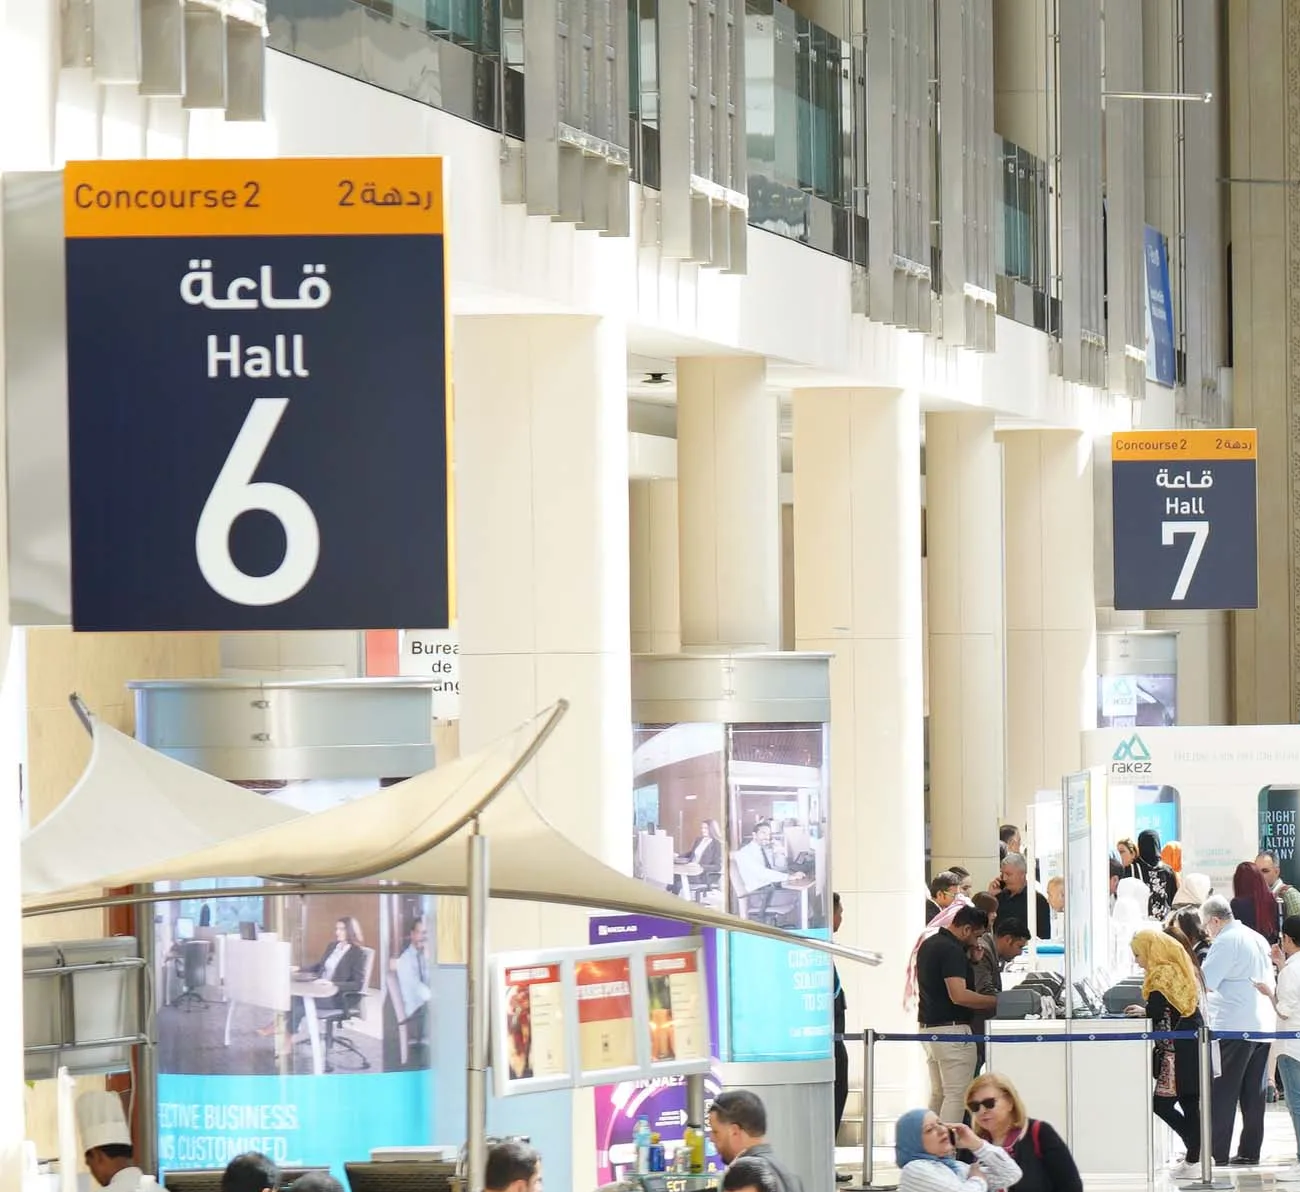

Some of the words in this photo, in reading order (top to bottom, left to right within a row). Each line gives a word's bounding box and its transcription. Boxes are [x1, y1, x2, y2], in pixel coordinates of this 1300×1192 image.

[75, 183, 237, 210] Concourse
[243, 181, 260, 209] 2
[337, 180, 355, 207] 2
[359, 182, 433, 211] ردهة
[180, 258, 332, 311] قاعة
[206, 334, 310, 378] Hall
[1115, 439, 1178, 450] Concourse
[1180, 439, 1188, 450] 2
[1216, 439, 1223, 449] 2
[1225, 439, 1252, 450] ردهة
[1156, 469, 1214, 489] قاعة
[195, 397, 320, 606] 6
[1166, 497, 1205, 515] Hall
[1161, 521, 1210, 600] 7
[431, 660, 452, 673] de
[1112, 760, 1152, 773] rakez
[1276, 824, 1296, 836] FOR
[204, 1104, 299, 1130] BUSINESS
